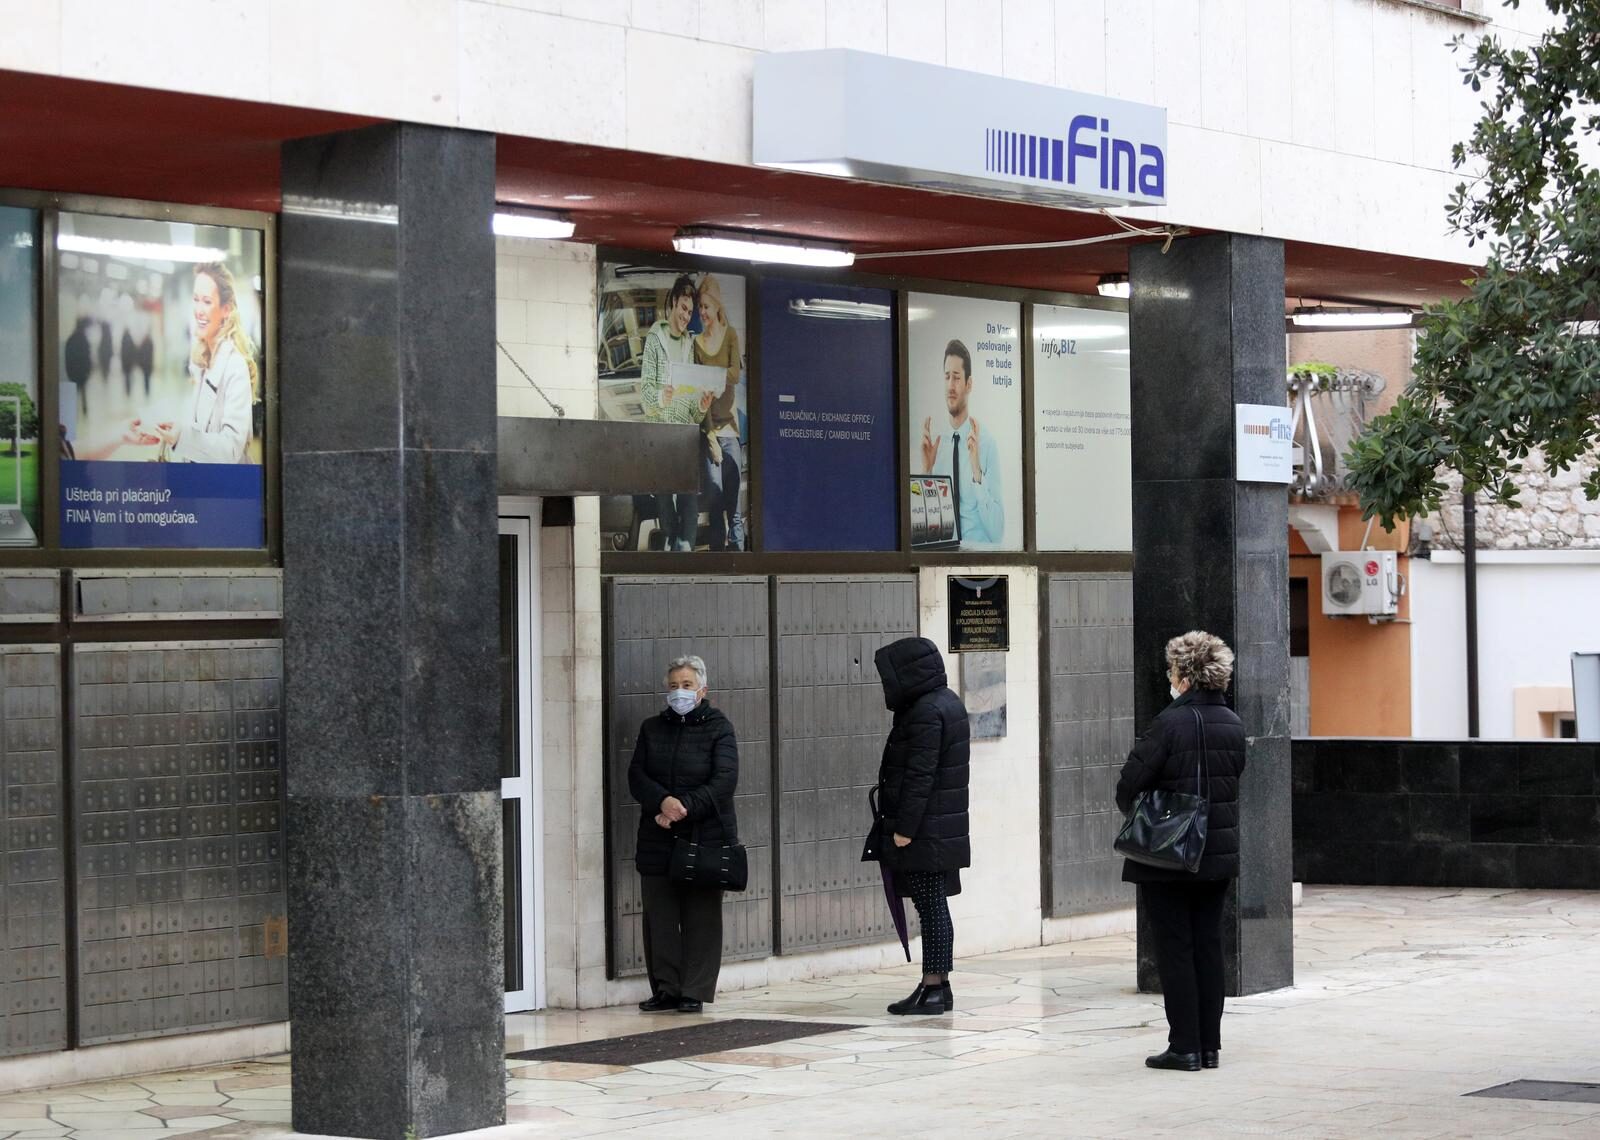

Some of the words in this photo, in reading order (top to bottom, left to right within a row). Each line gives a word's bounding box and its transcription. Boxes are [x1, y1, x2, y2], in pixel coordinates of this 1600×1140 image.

[986, 323, 996, 334] Da
[976, 340, 1012, 354] poslovanje
[985, 359, 994, 368] ne
[995, 358, 1012, 369] bude
[992, 374, 1012, 388] lutrija
[821, 413, 850, 422] EXCHANGE
[851, 414, 871, 424] OFFICE
[780, 428, 824, 439] WECHSELSTUBE
[828, 430, 850, 440] CAMBIO
[851, 432, 871, 441] VALUTE
[65, 487, 103, 502] Ušteda
[105, 488, 120, 504] pri
[121, 488, 171, 504] plaćanju?
[66, 509, 91, 523] FINA
[92, 510, 117, 523] Vam
[124, 511, 135, 523] to
[137, 510, 198, 526] omogućava.
[1366, 577, 1378, 587] LG
